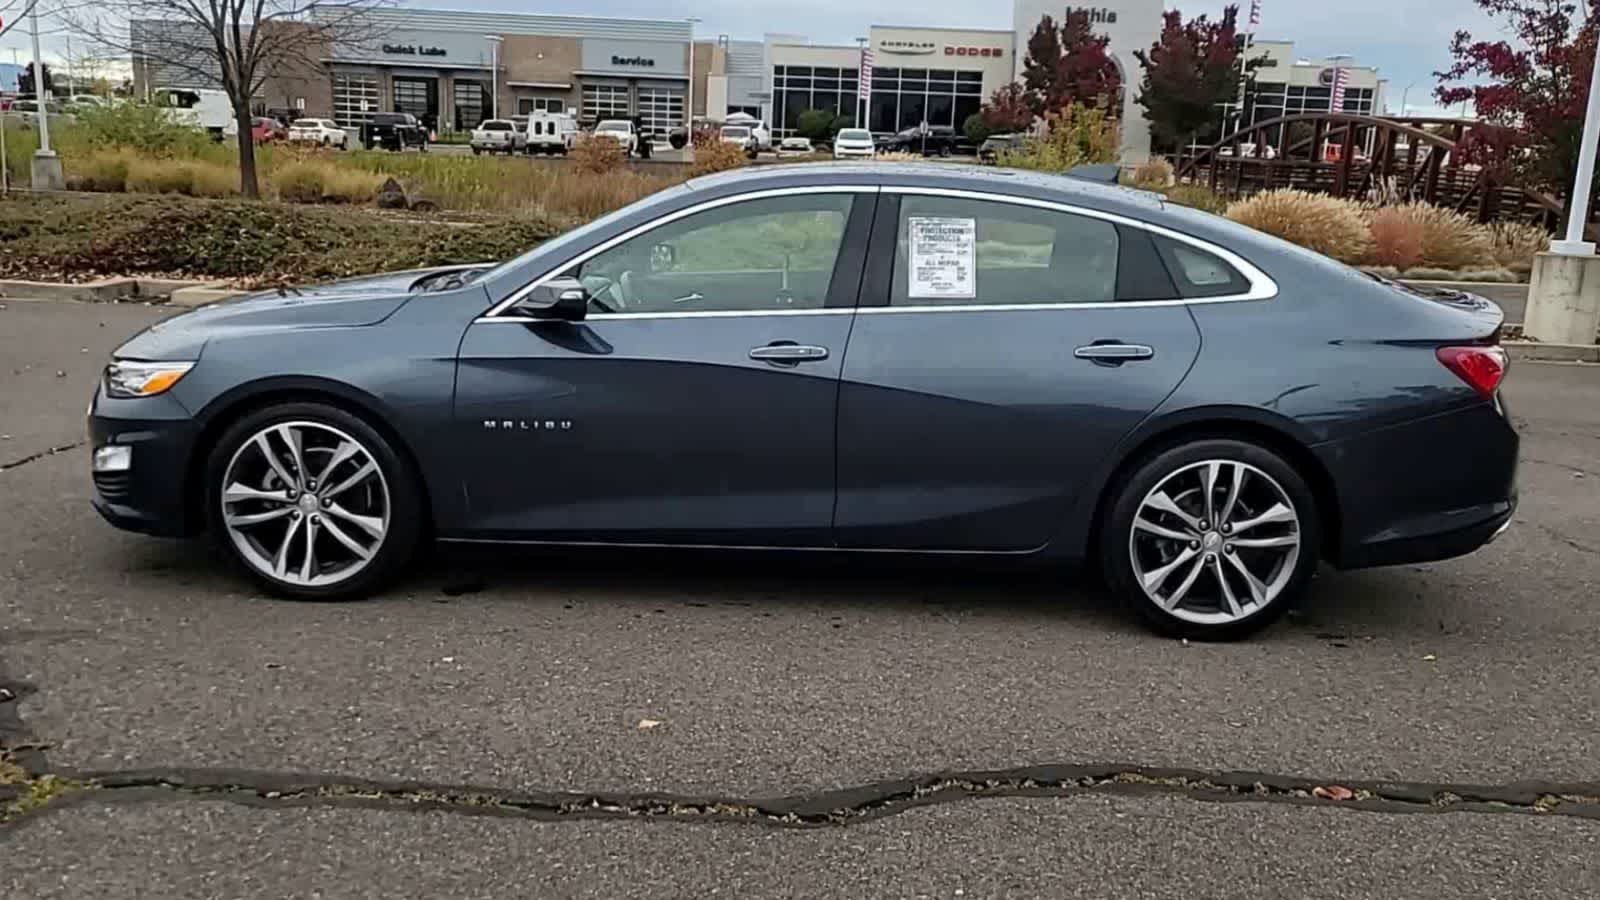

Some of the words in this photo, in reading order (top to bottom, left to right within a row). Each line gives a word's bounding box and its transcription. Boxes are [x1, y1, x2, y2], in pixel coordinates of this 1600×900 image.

[1066, 6, 1117, 23] Lhia
[383, 44, 416, 54] Quick
[419, 45, 447, 56] Lube
[944, 46, 1003, 57] DODGE
[611, 55, 655, 66] Service
[484, 420, 571, 430] MALIBU
